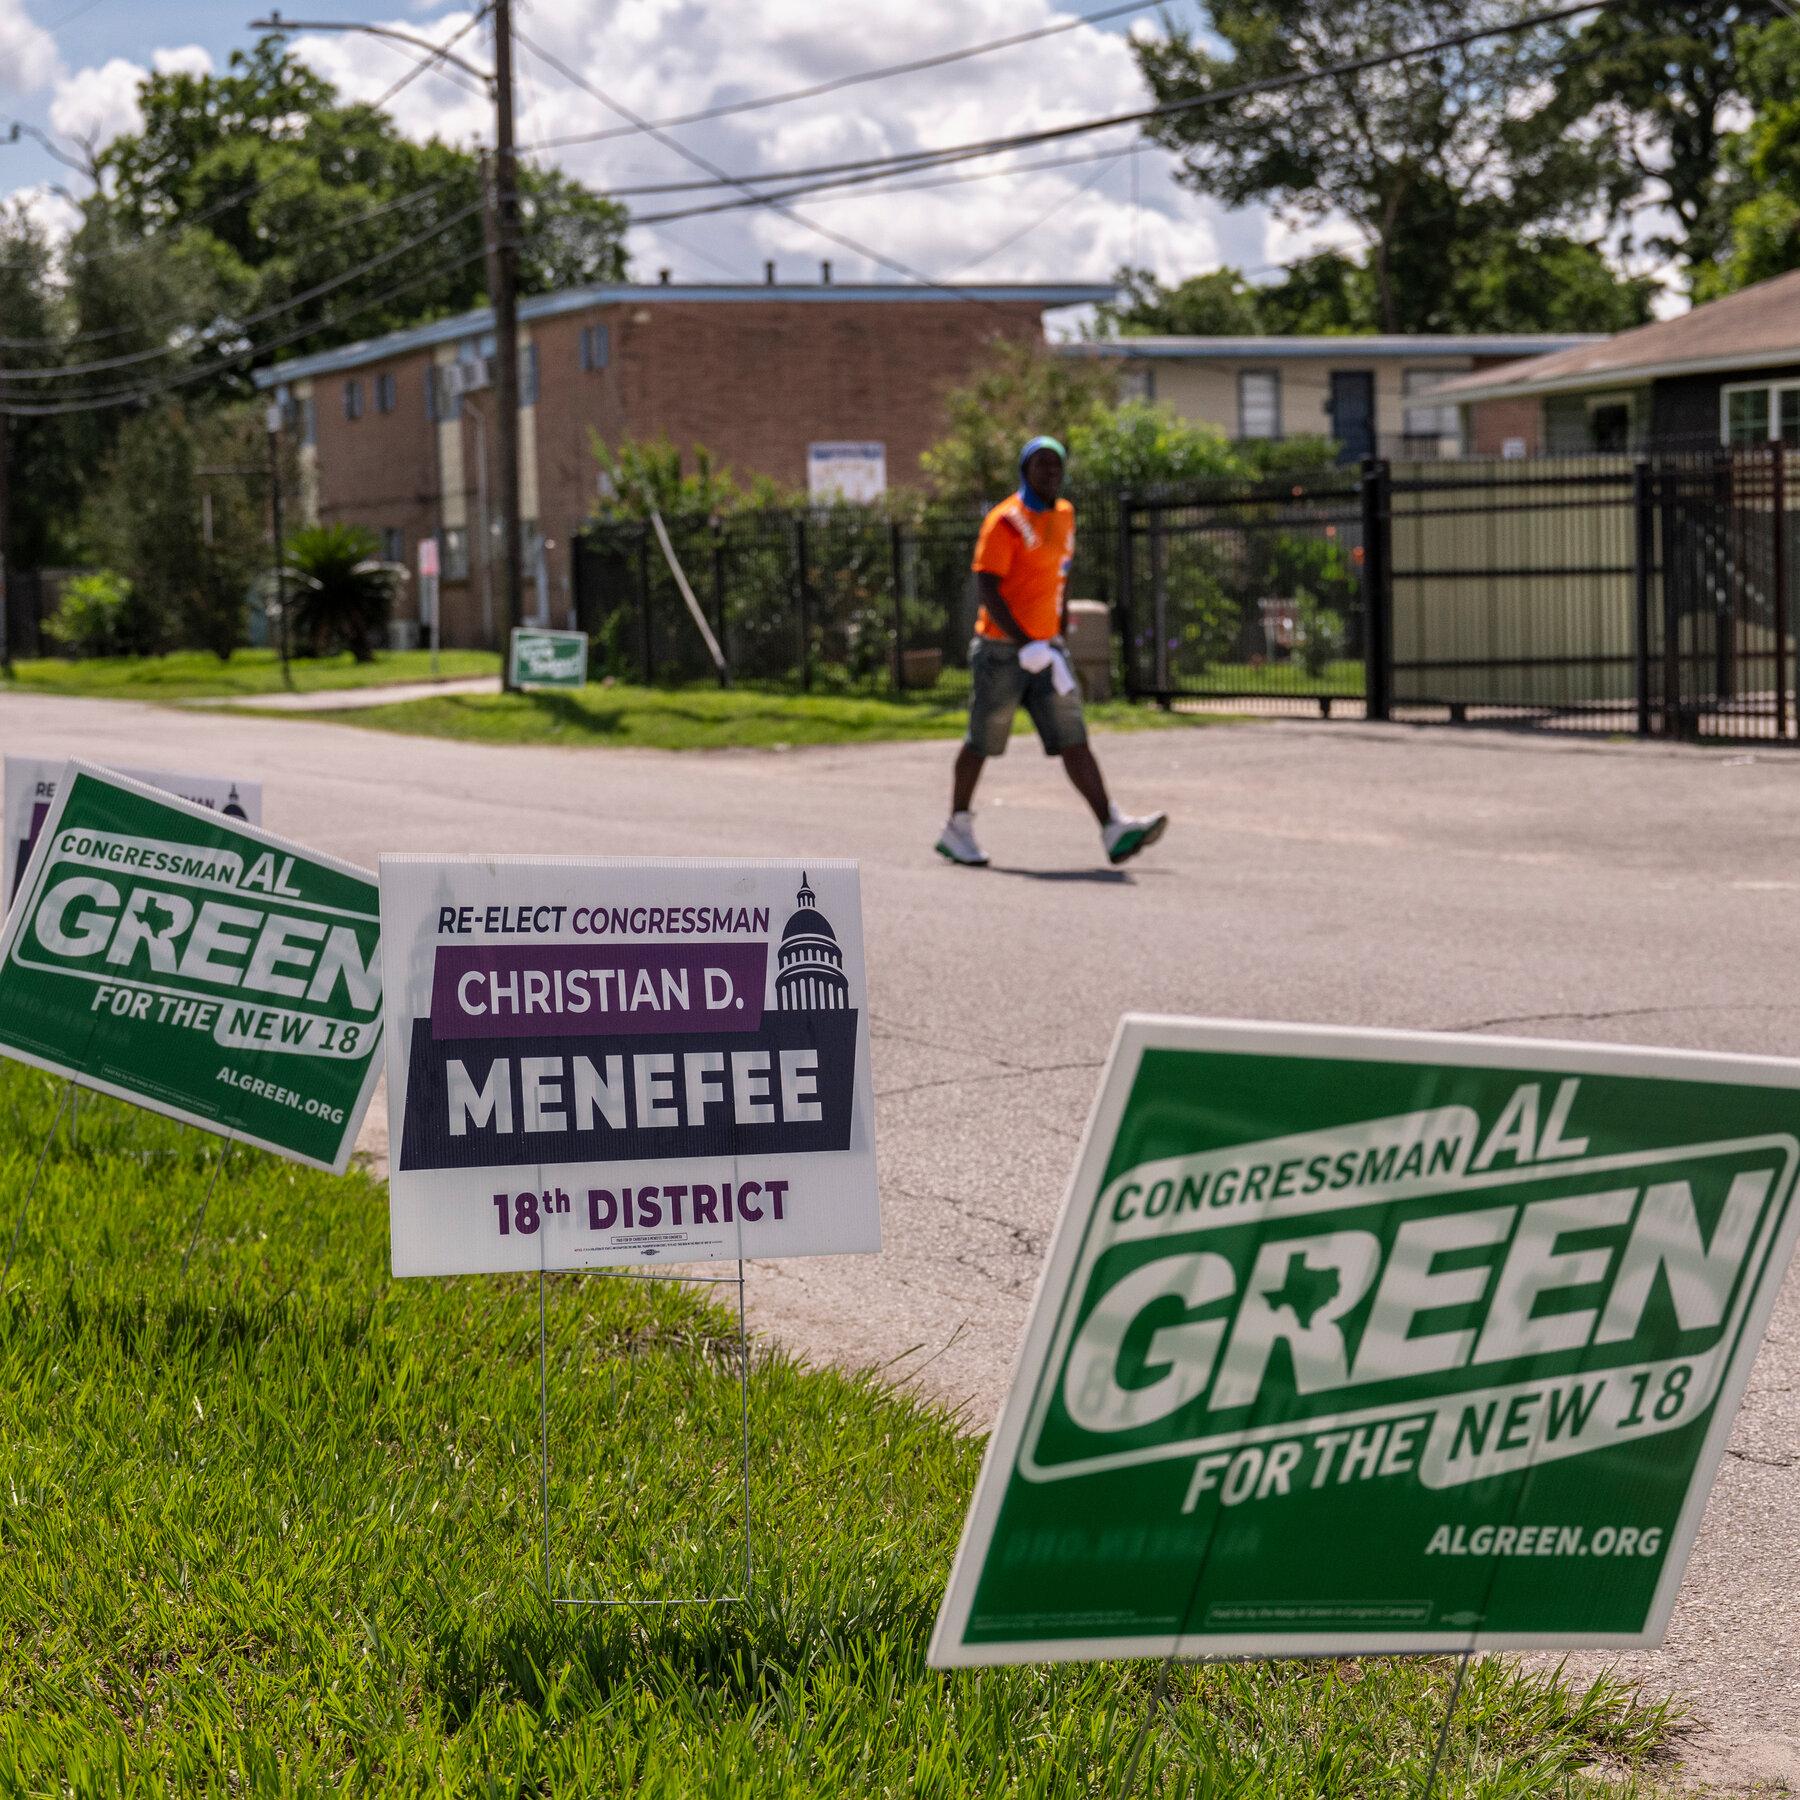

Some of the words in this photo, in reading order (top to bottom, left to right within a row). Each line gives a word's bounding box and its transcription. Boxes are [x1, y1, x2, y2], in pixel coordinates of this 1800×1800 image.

[61, 834, 236, 885] CONGRESSMAN
[240, 851, 301, 898] AL
[34, 877, 383, 1012] GREEN
[437, 906, 566, 934] RE-ELECT
[572, 906, 770, 934] CONGRESSMAN
[91, 985, 155, 1021] FOR
[157, 996, 217, 1033] THE
[228, 1006, 312, 1046] NEW
[318, 1022, 361, 1054] 18
[457, 969, 688, 1016] CHRISTIAN
[704, 968, 745, 1010] D.
[215, 1065, 344, 1125] ALGREEN.ORG
[445, 1049, 823, 1136] MENEFEE
[1110, 1134, 1463, 1224] CONGRESSMAN
[1475, 1078, 1590, 1169] AL
[493, 1188, 571, 1235] 18th
[588, 1180, 789, 1231] DISTRICT
[1063, 1168, 1776, 1434] GREEN
[1181, 1447, 1310, 1514] FOR
[1309, 1415, 1438, 1487] THE
[1447, 1380, 1606, 1465] NEW
[1615, 1364, 1694, 1428] 18
[1425, 1523, 1663, 1558] ALGREEN.ORG
